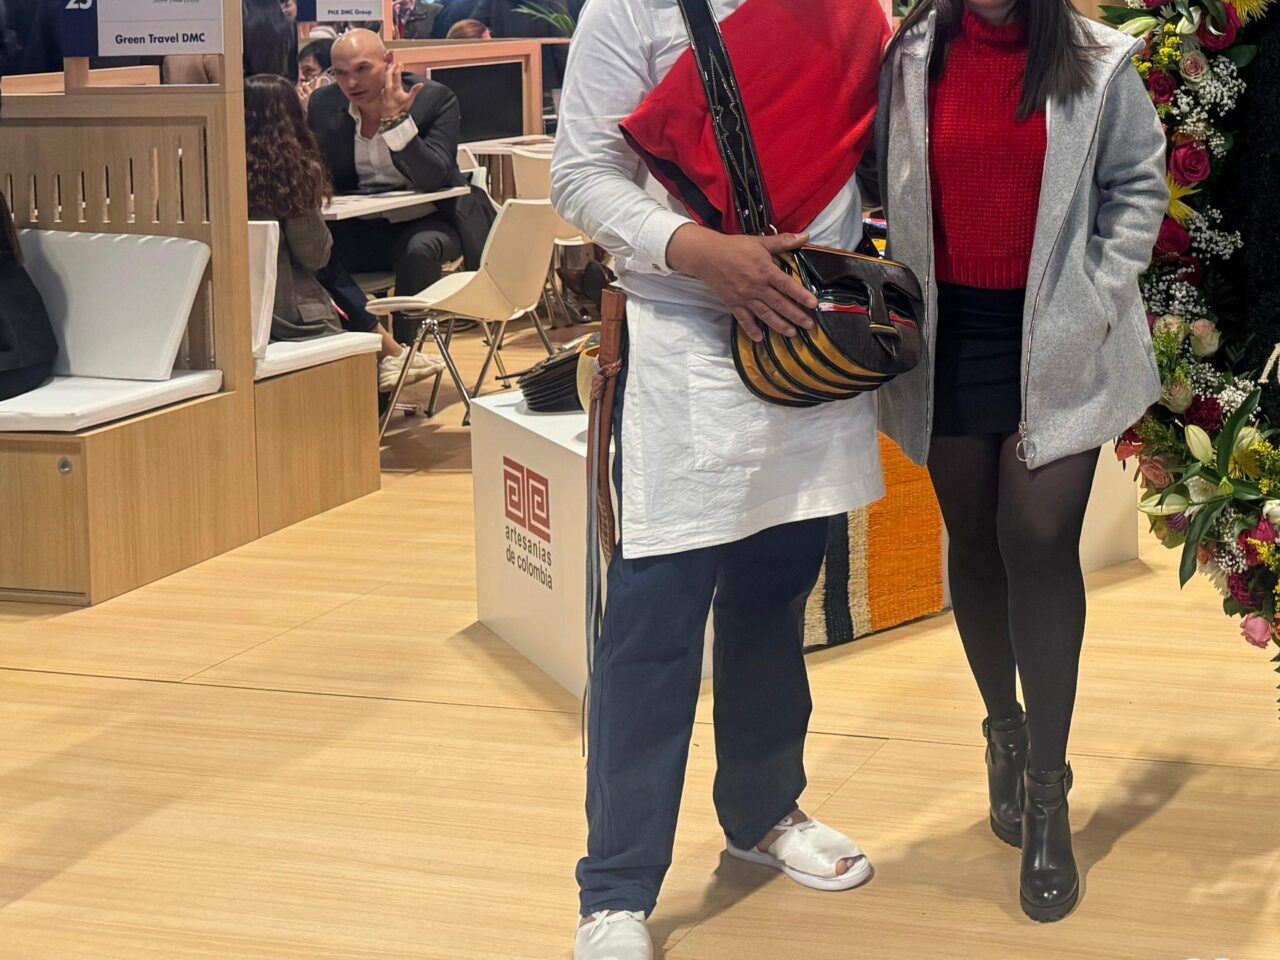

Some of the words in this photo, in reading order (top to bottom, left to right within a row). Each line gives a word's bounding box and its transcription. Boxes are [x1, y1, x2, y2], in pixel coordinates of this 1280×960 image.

[115, 34, 145, 44] Green
[148, 33, 179, 44] Travel
[182, 33, 206, 43] DMC
[506, 544, 516, 565] de
[517, 555, 552, 590] colombia
